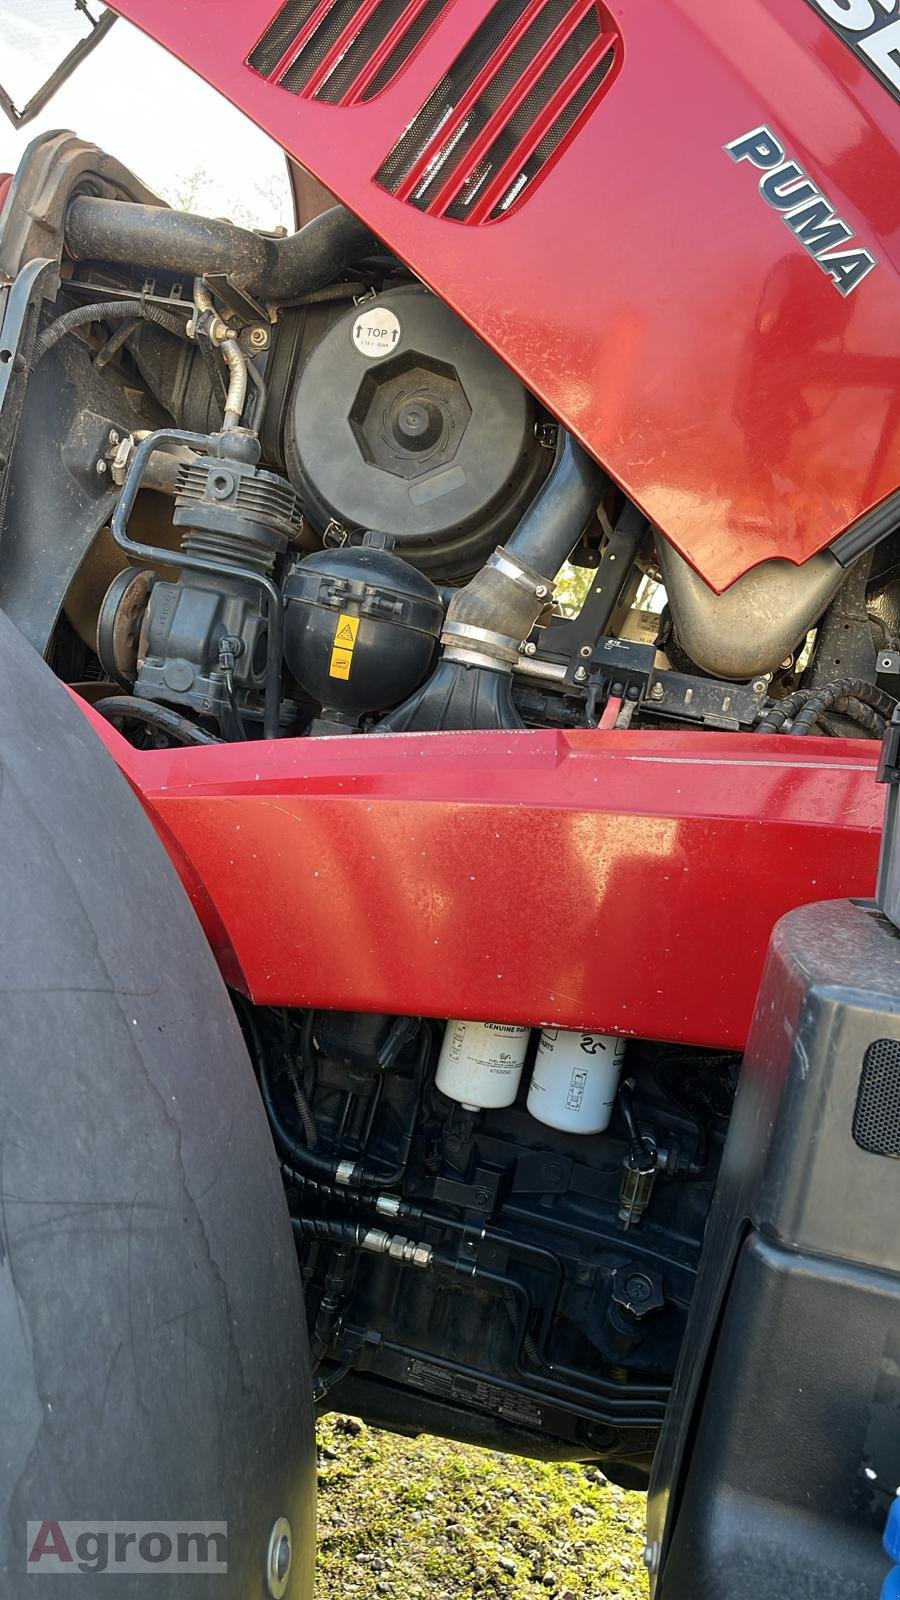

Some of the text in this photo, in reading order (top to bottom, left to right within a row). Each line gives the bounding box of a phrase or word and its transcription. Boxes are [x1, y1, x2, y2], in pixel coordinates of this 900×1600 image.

[721, 123, 878, 298] PUMA
[367, 327, 388, 338] TOP
[484, 1022, 515, 1033] GENUINE
